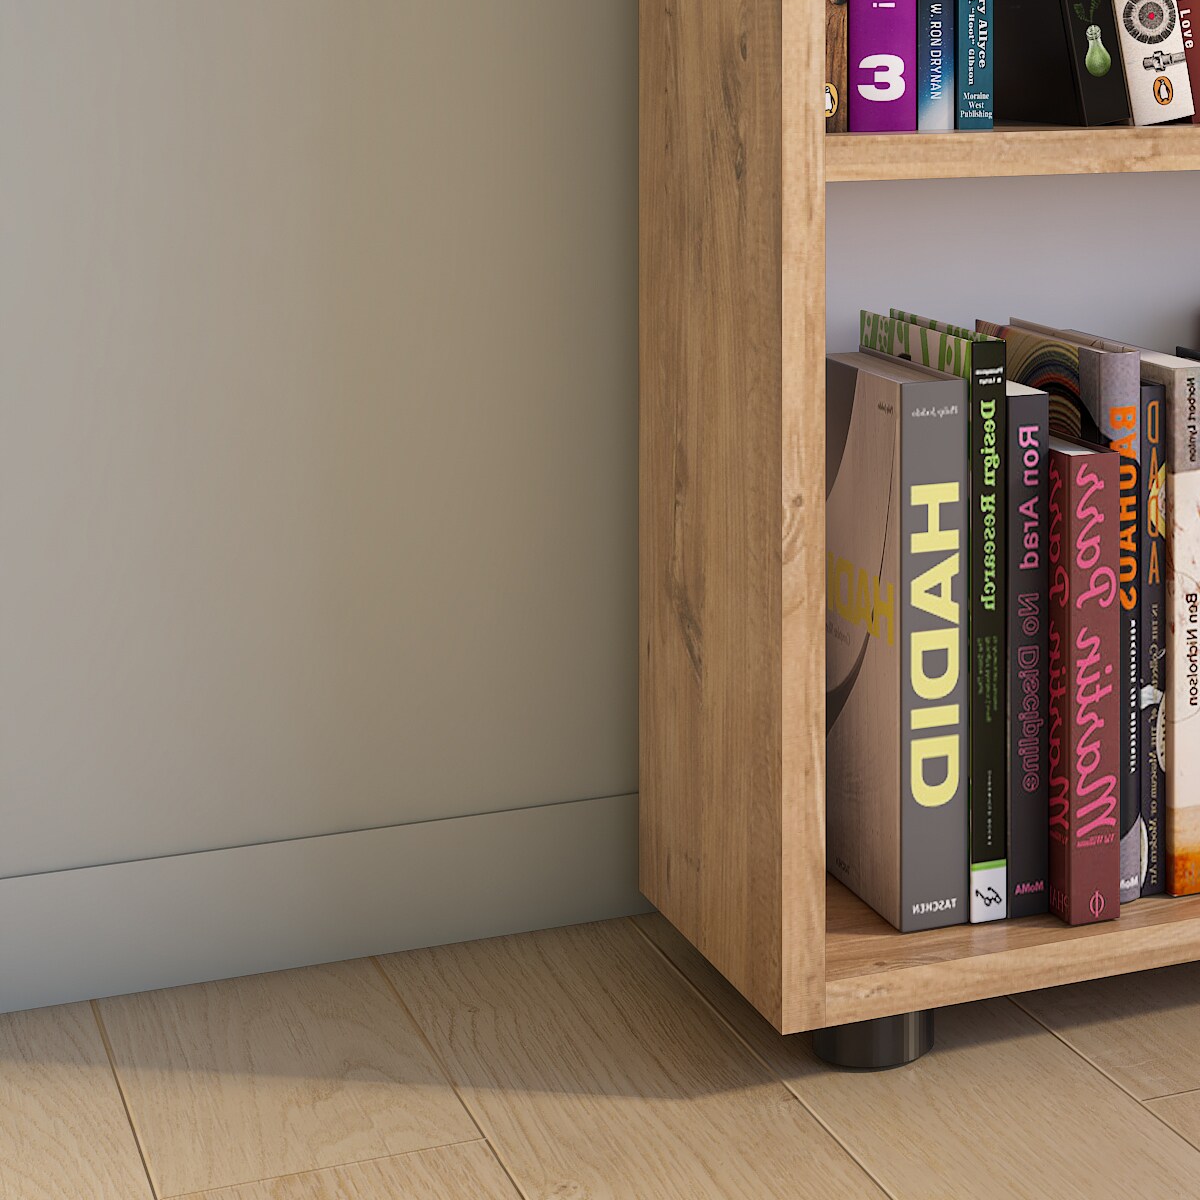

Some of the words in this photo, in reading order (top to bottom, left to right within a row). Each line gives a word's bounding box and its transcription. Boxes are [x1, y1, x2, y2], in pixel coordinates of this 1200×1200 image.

[930, 4, 942, 19] W.
[930, 24, 942, 46] RON
[1180, 8, 1194, 49] Love
[978, 19, 988, 68] Allyce
[857, 53, 906, 102] 3
[930, 49, 942, 100] DRYNAN
[963, 92, 990, 100] Moraine
[968, 101, 984, 110] West
[960, 110, 992, 119] Publishing
